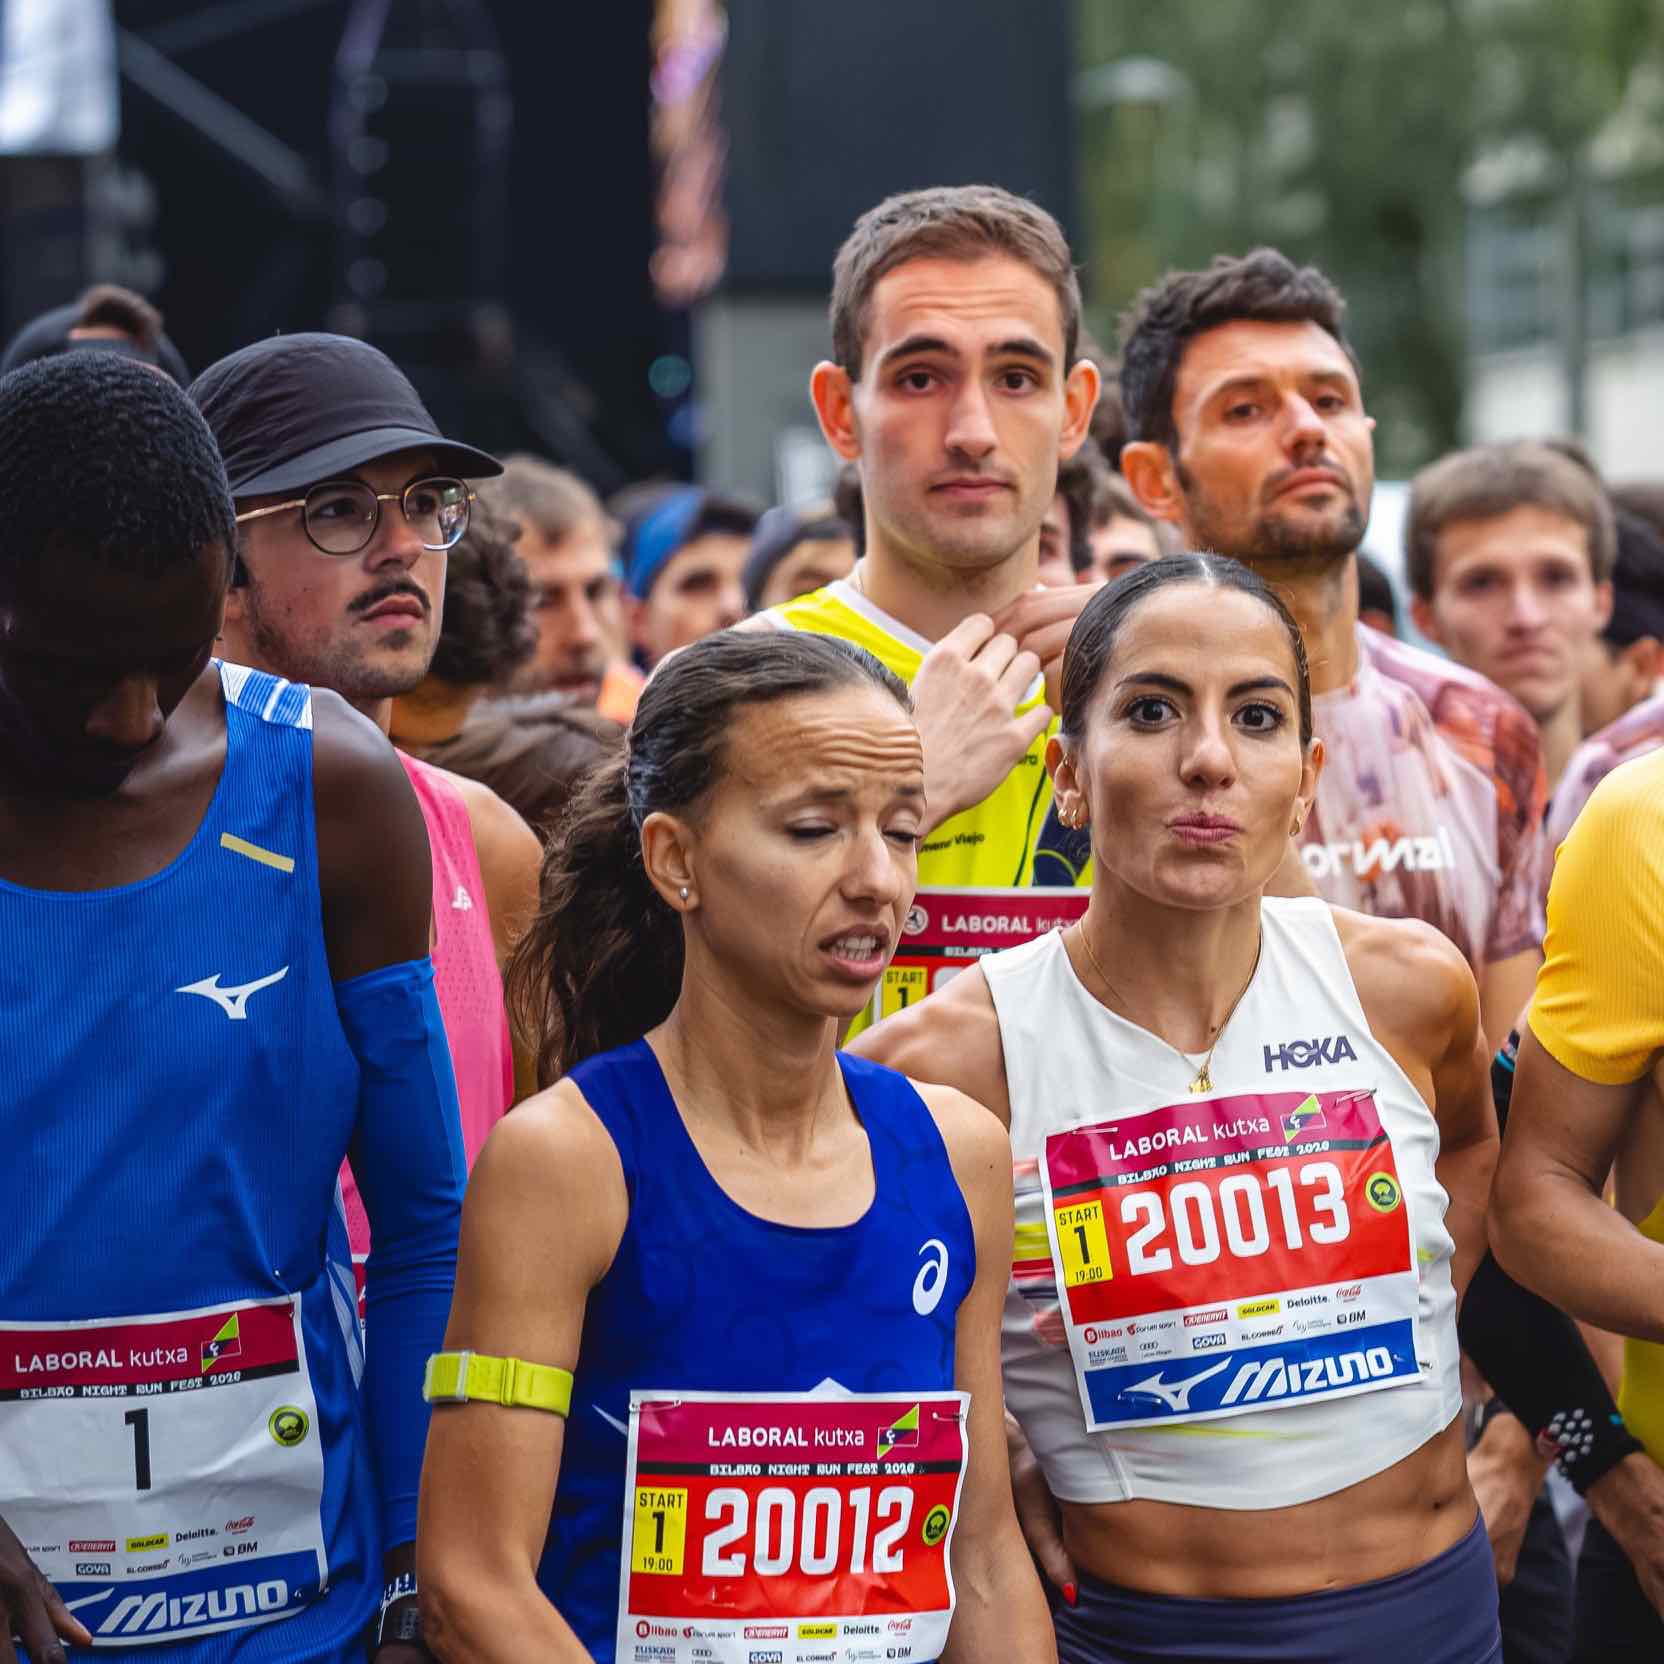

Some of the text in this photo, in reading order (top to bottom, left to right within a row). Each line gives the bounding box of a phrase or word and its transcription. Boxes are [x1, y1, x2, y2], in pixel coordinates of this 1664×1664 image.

[941, 915, 1033, 933] LABORAL
[885, 969, 924, 984] START
[1263, 1035, 1358, 1073] HOKA
[1109, 1116, 1270, 1161] LABORAL kutxa
[1223, 1150, 1251, 1166] RUN
[1059, 1205, 1099, 1226] START
[1119, 1161, 1351, 1276] 20013
[1073, 1224, 1091, 1265] 1
[1075, 1265, 1103, 1282] 19:00
[15, 1347, 189, 1374] LABORAL kutxa
[82, 1384, 128, 1397] NIGHT
[136, 1382, 164, 1396] RUN
[707, 1426, 865, 1448] LABORAL kutxa
[124, 1407, 152, 1491] 1
[768, 1463, 811, 1476] NIGHT
[817, 1463, 841, 1475] RUN
[847, 1462, 879, 1475] FEST
[639, 1492, 685, 1509] START
[652, 1511, 666, 1554] 1
[702, 1485, 915, 1577] 20012
[642, 1556, 674, 1571] 19:00
